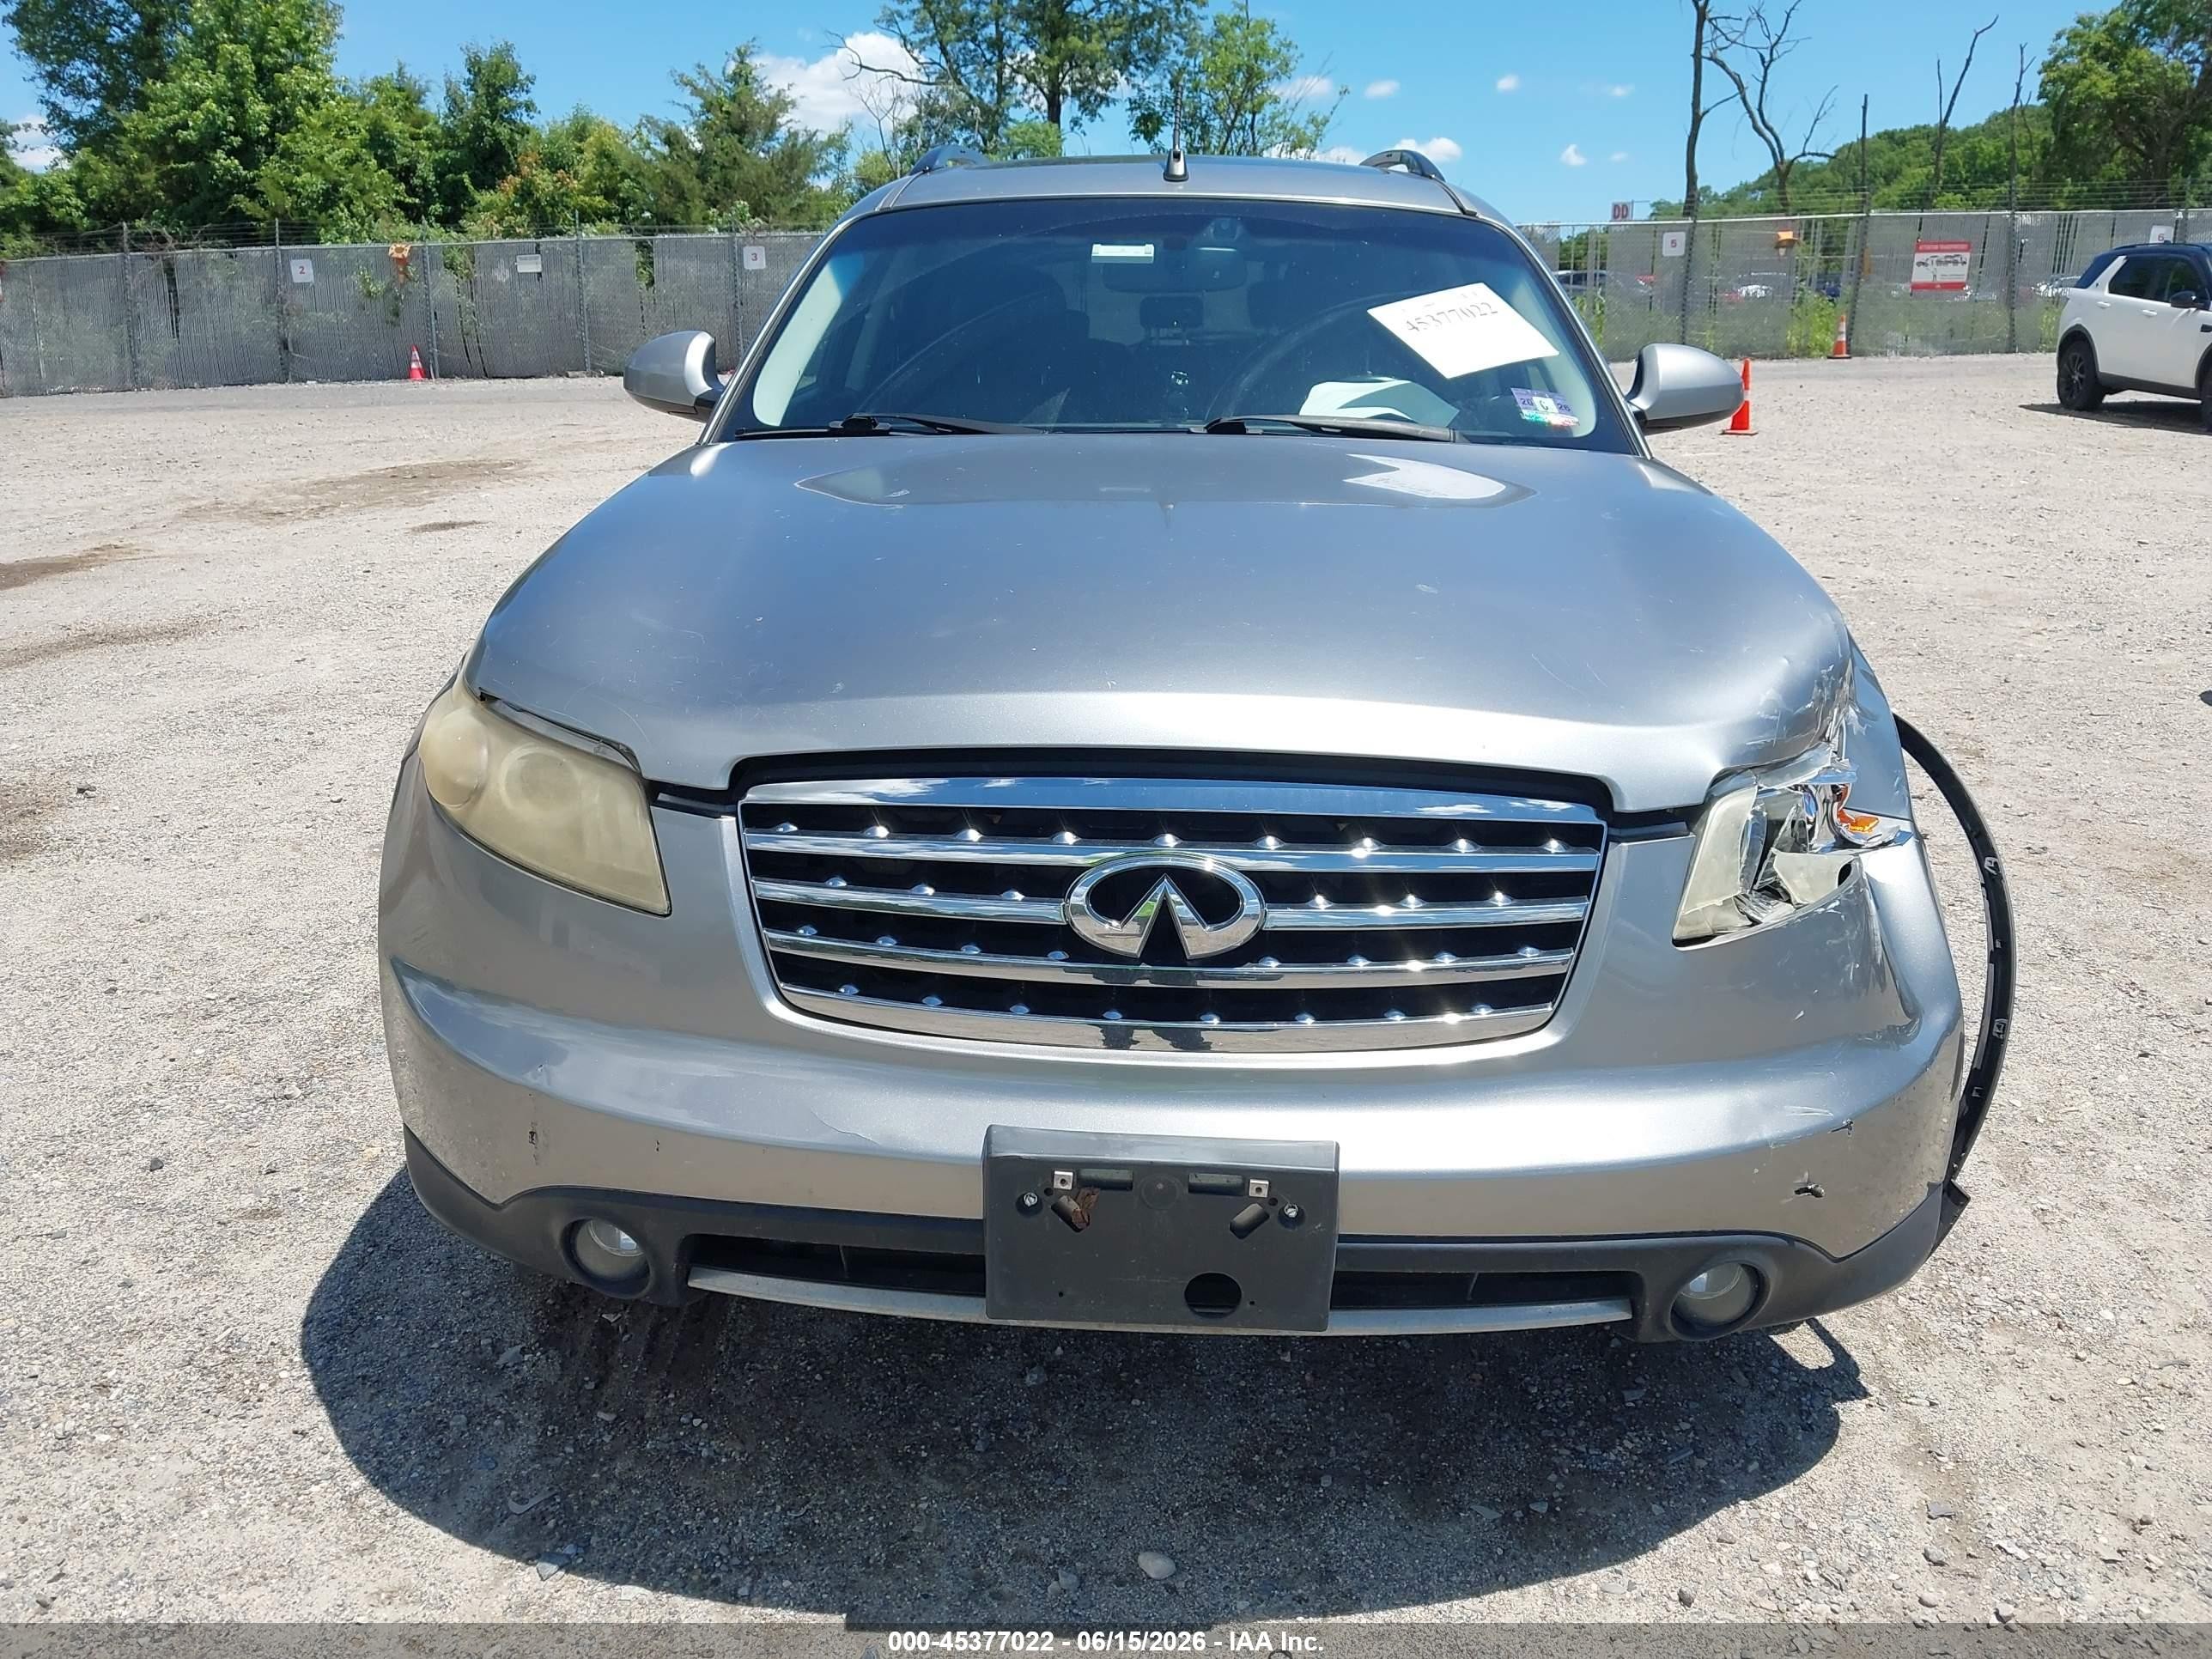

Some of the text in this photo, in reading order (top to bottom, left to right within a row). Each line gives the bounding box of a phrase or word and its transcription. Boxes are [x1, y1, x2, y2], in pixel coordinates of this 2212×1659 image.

[2157, 233, 2165, 242] 6
[1670, 239, 1678, 248] 5
[750, 252, 758, 262] 3
[298, 265, 306, 275] 2
[1406, 301, 1498, 331] 45377022
[1519, 398, 1534, 406] 20
[1556, 403, 1571, 412] 26
